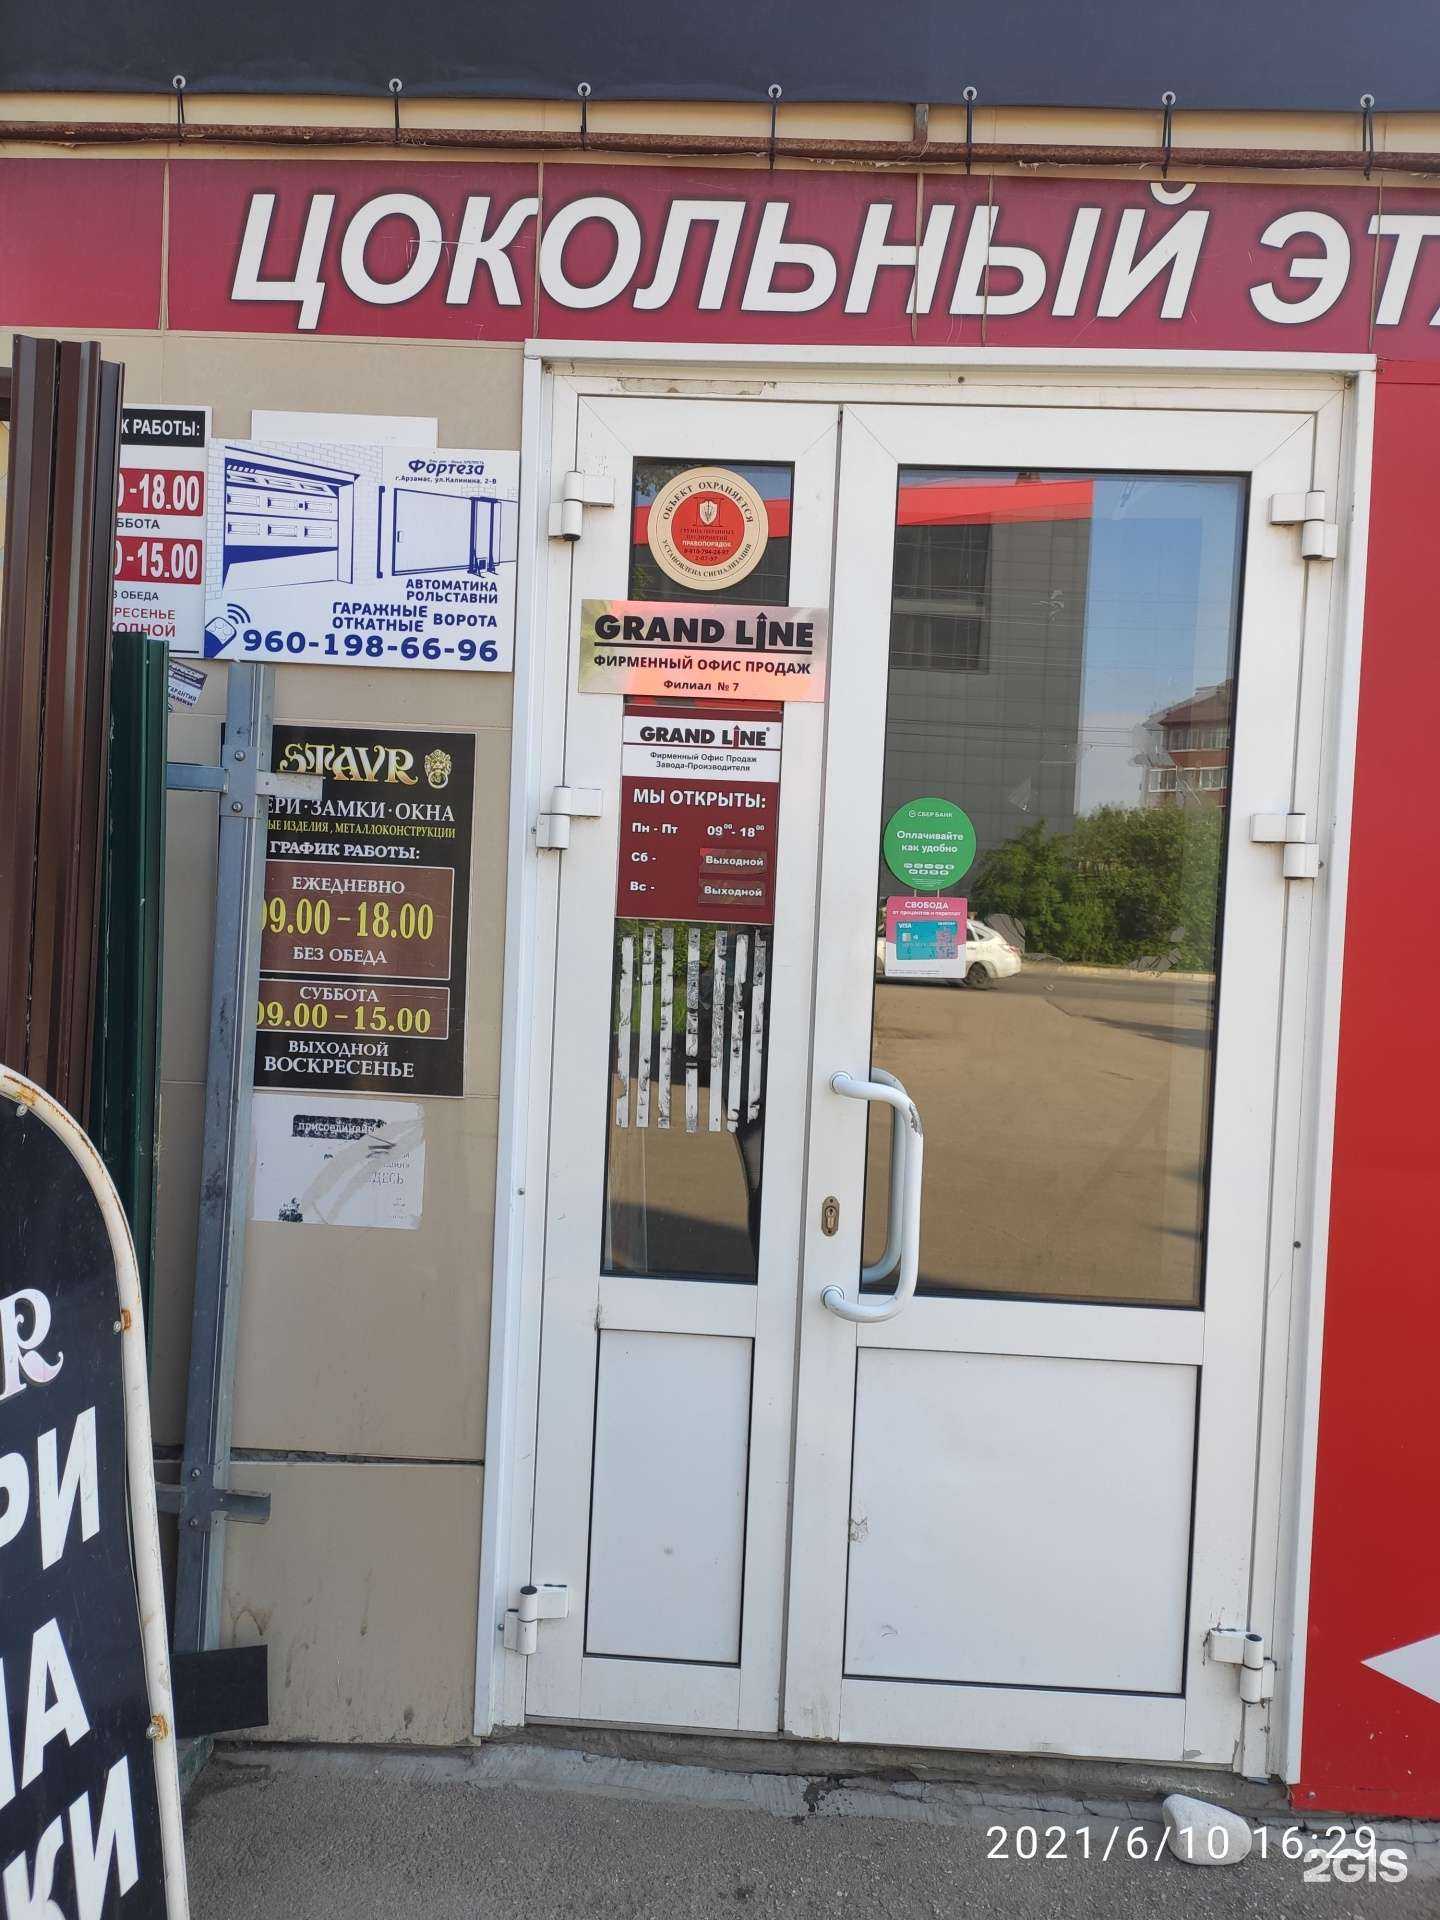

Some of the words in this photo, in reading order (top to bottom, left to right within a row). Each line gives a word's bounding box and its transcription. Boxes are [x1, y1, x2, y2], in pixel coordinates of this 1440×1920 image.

[231, 182, 1210, 330] ЦОКОЛЬНЫЙ
[1249, 211, 1440, 326] ЭТ
[133, 419, 200, 436] РАБОТЫ:
[408, 459, 485, 477] Фортеза
[663, 484, 693, 520] ОБЪЕКТ
[698, 481, 754, 523] ОХРАНЯЕТСЯ
[117, 518, 160, 529] ББОТА
[406, 579, 498, 592] АВТОМАТИКА
[121, 590, 159, 601] ОБЕДА
[406, 591, 498, 604] РОЛЬСТАВНИ
[114, 607, 176, 620] РЕСЕНЬЕ
[332, 602, 428, 618] ГАРАЖНЫЕ
[433, 613, 498, 628] ВОРОТА
[332, 616, 424, 633] ОТКАТНЫЕ
[594, 614, 725, 643] GRAND
[735, 612, 814, 650] LINE
[243, 629, 499, 663] 960-198-66-96
[594, 655, 693, 671] ФИРМЕННЫЙ
[697, 659, 741, 673] ОФИС
[745, 660, 811, 676] ПРОДАЖ
[663, 680, 711, 691] Филиал
[733, 682, 739, 692] 7
[640, 726, 715, 744] GRAND
[279, 742, 419, 786] STAVR
[650, 751, 699, 761] Фирменный
[701, 753, 724, 762] Офис
[726, 754, 757, 763] Продаж
[633, 789, 665, 804] МЫ
[669, 790, 766, 808] ОТКРЫТЫ:
[310, 799, 385, 819] ЗАМКИ
[395, 802, 456, 822] ОКНА
[632, 822, 650, 833] Пн
[662, 824, 678, 834] Пт
[896, 831, 963, 840] Оплачивайте
[270, 841, 340, 857] ГРАФИК
[343, 844, 420, 859] РАБОТЫ:
[901, 844, 919, 852] как
[922, 844, 957, 853] удобно
[631, 852, 648, 862] Сб
[705, 855, 764, 867] Выходной
[292, 876, 406, 895] ЕЖЕДНЕВНО
[630, 882, 647, 892] Вс
[704, 886, 762, 897] Выходной
[905, 901, 948, 909] СВОБОДА
[356, 901, 434, 940] 18.00
[293, 946, 324, 961] БЕЗ
[329, 948, 388, 966] ОБЕДА
[300, 986, 380, 1002] СУББОТА
[354, 1006, 431, 1033] 15.00
[288, 1040, 389, 1057] ВЫХОДНОЙ
[264, 1056, 415, 1078] ВОСКРЕСЕНЬЕ
